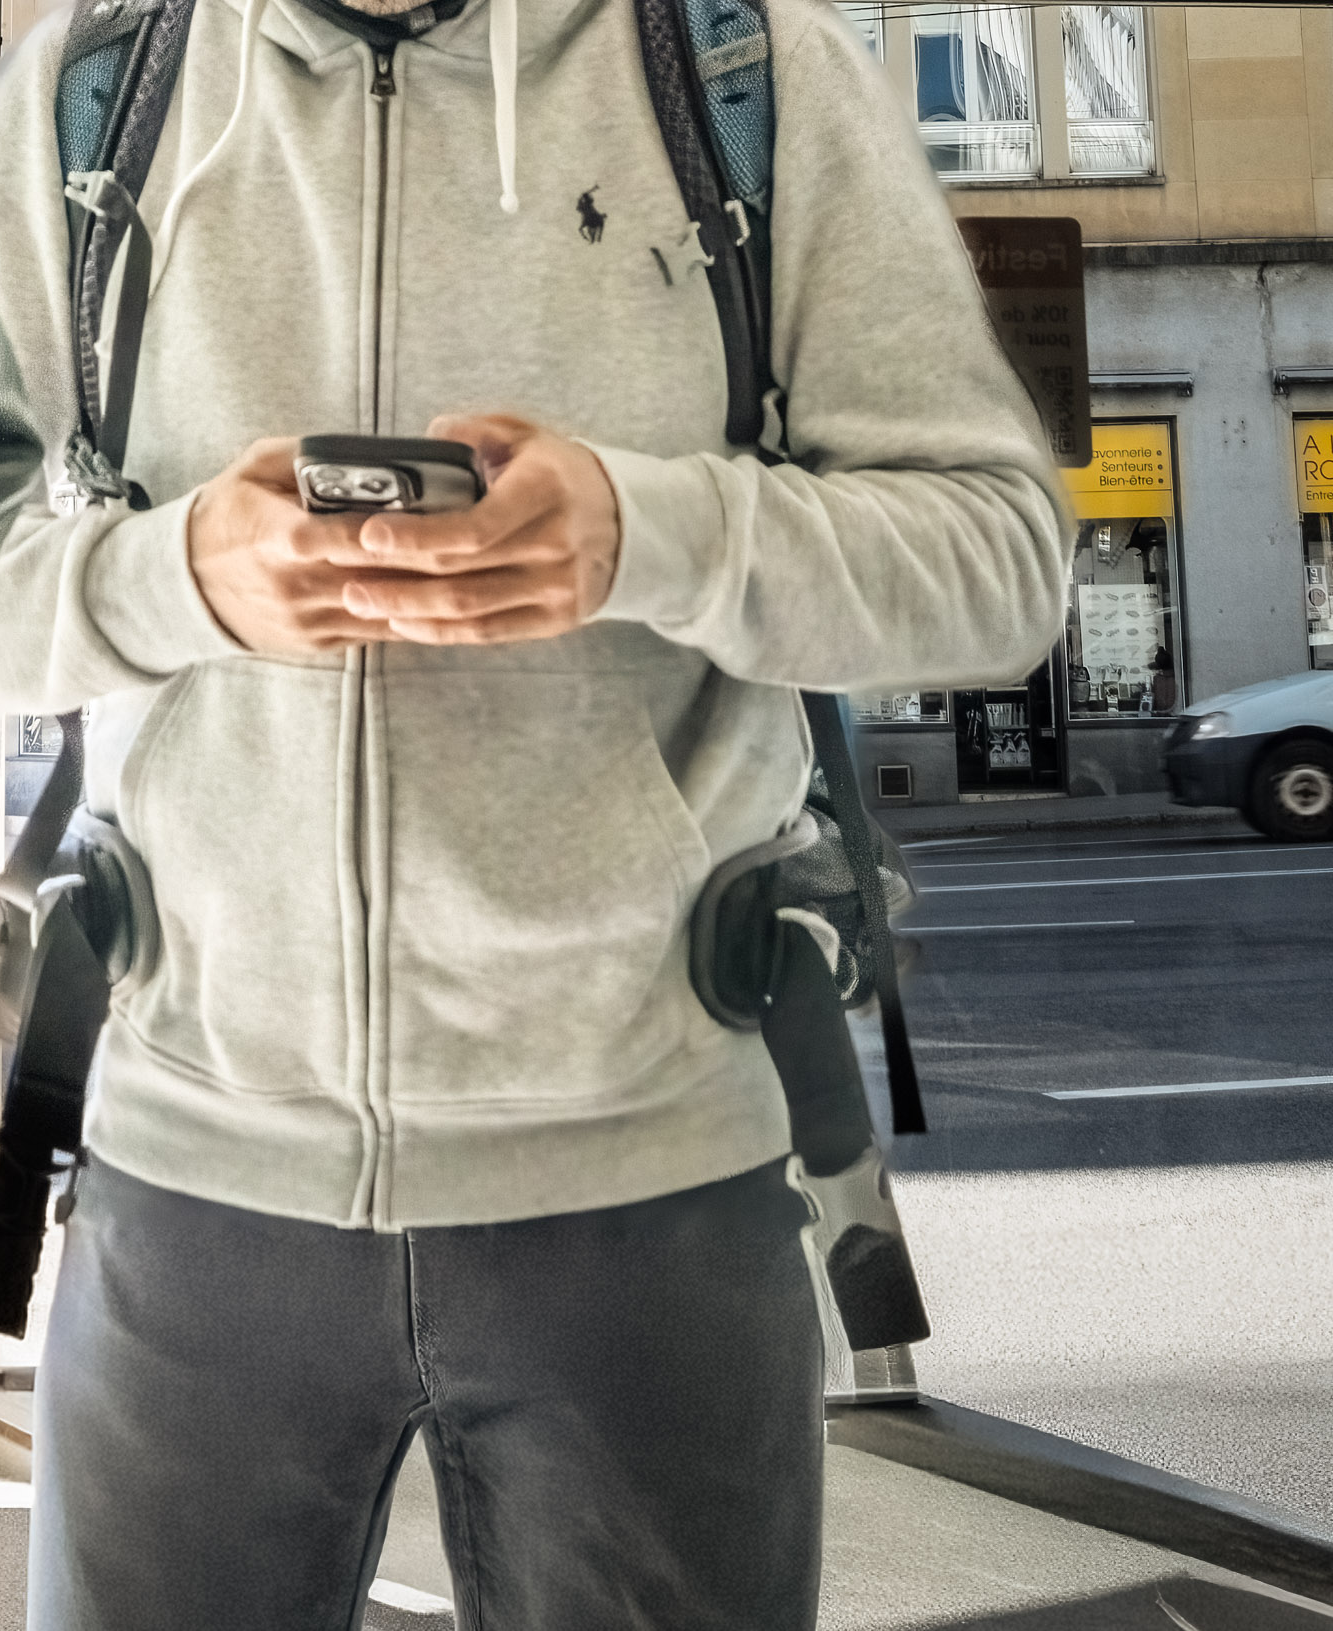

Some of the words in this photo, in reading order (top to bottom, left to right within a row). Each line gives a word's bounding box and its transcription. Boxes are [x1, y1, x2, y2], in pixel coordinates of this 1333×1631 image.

[1302, 435, 1321, 455] A
[1101, 461, 1153, 472] Senteurs
[1099, 475, 1154, 486] Bien-être
